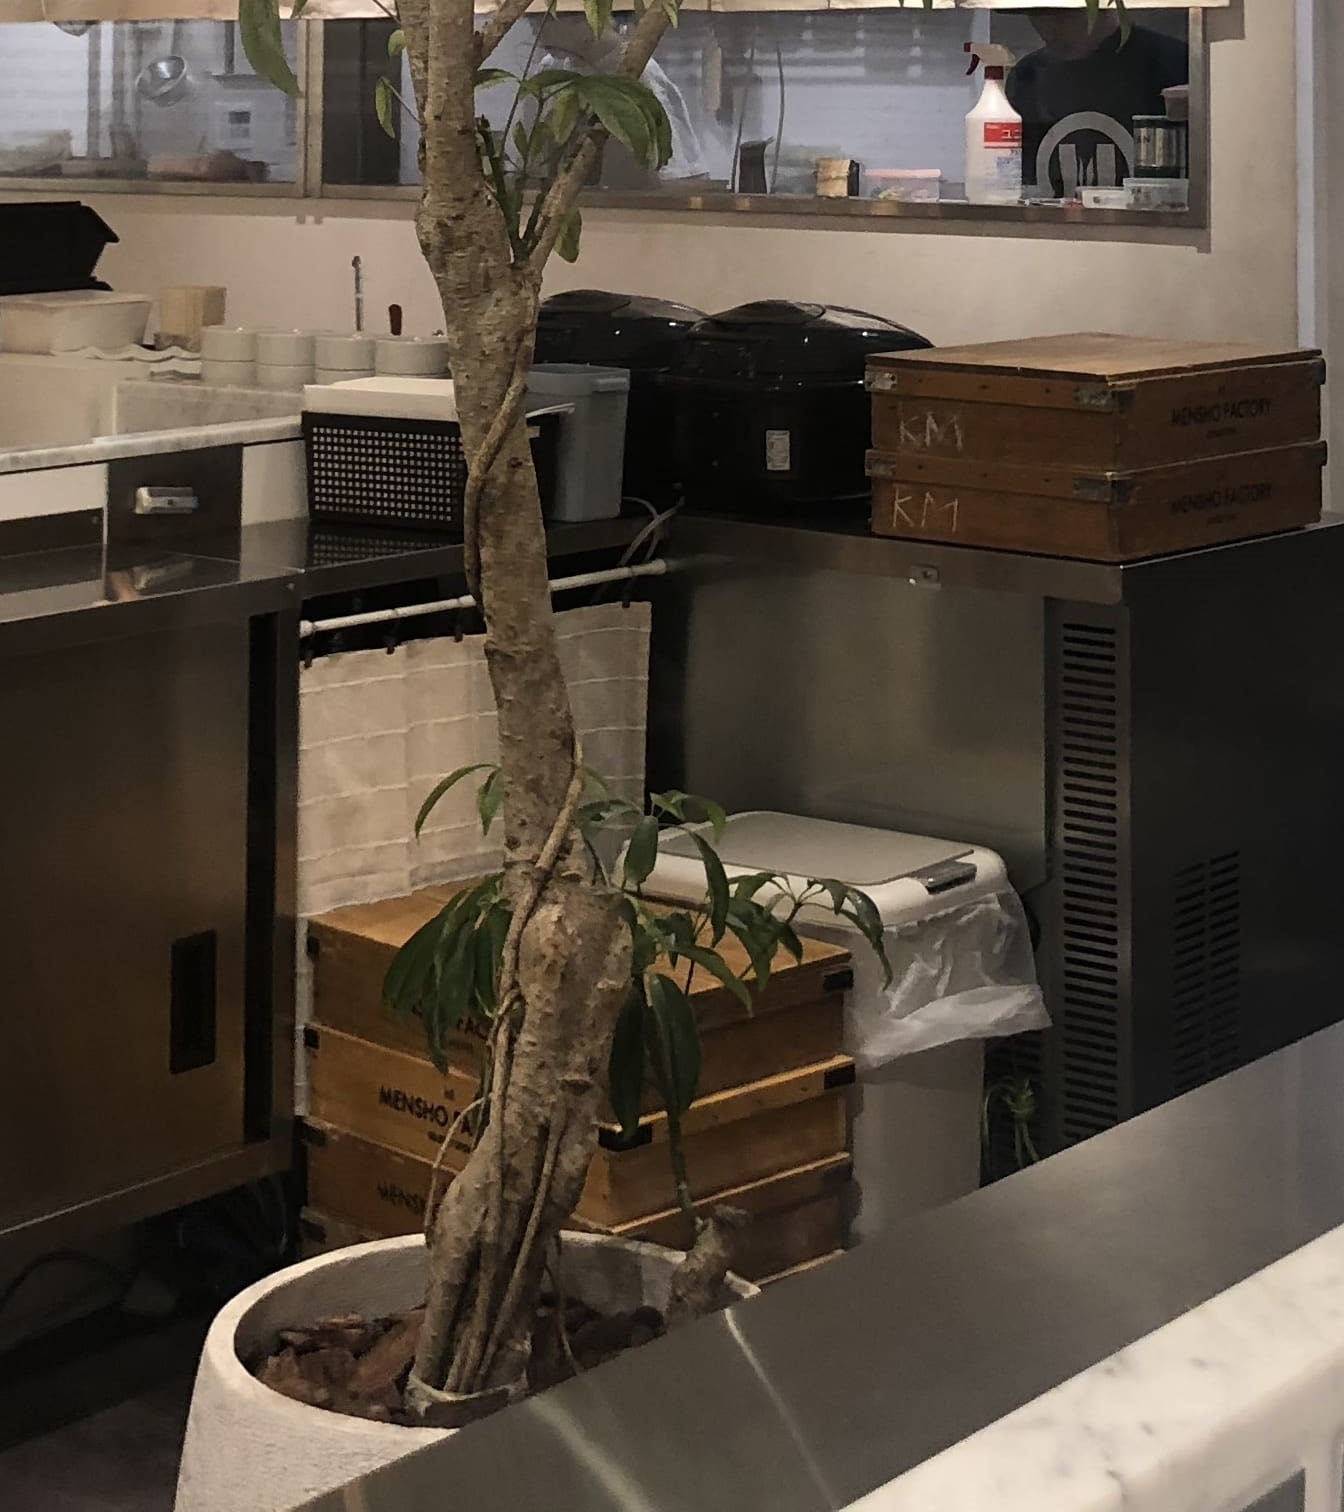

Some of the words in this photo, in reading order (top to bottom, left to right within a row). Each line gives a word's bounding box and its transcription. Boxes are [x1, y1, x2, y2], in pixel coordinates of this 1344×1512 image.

[1171, 402, 1221, 425] MENSHO
[1223, 398, 1273, 418] FACTORY
[379, 1087, 449, 1127] MENSHO
